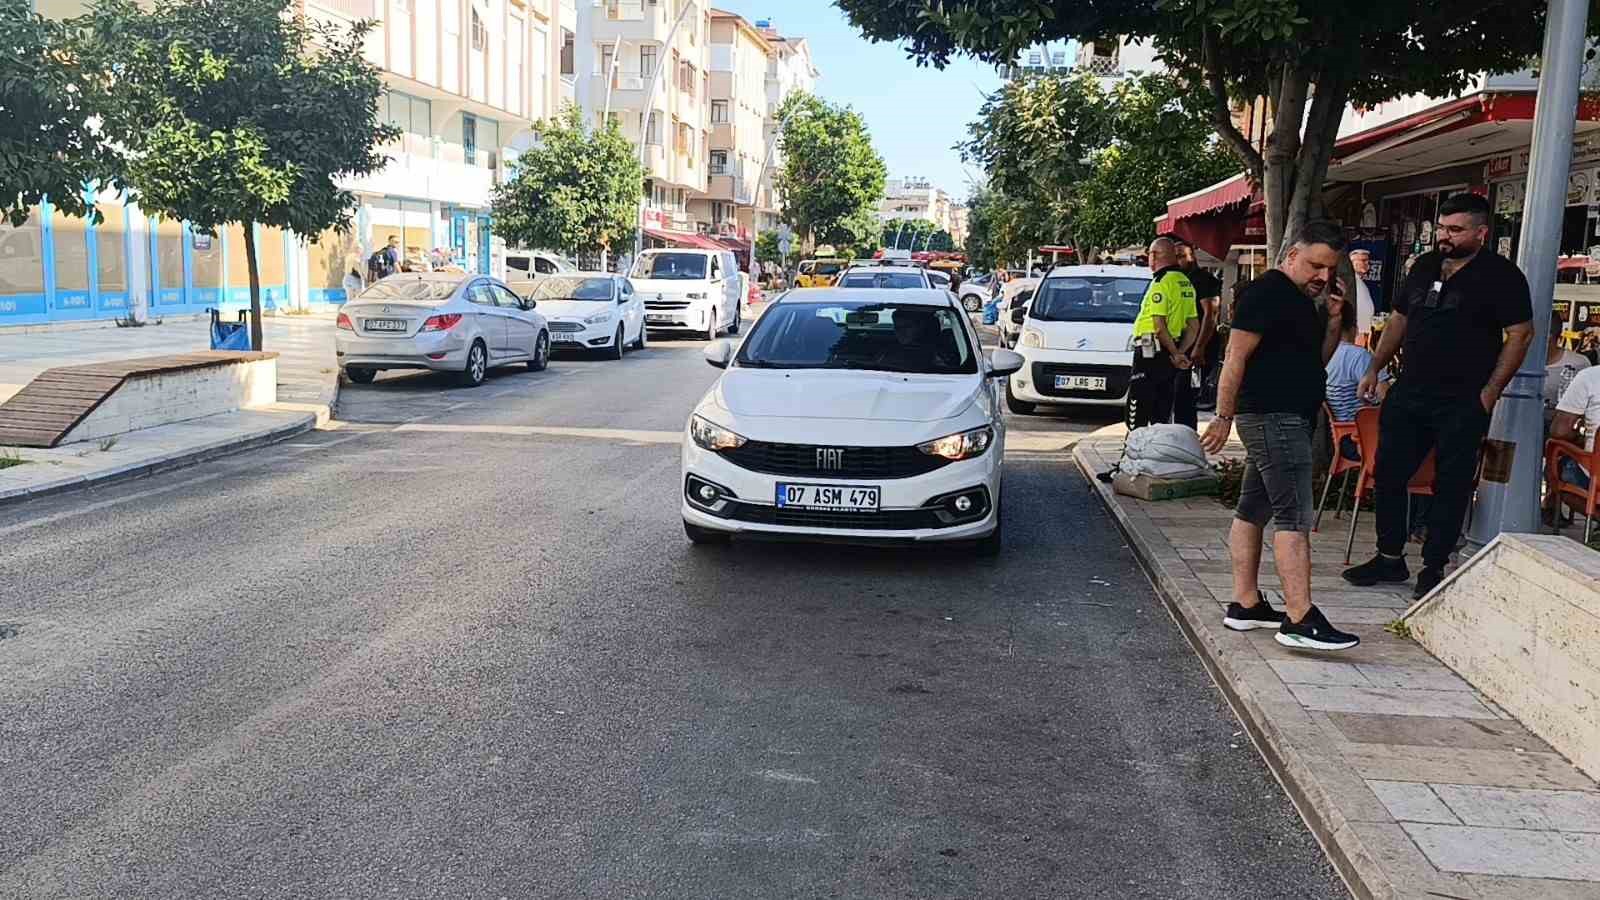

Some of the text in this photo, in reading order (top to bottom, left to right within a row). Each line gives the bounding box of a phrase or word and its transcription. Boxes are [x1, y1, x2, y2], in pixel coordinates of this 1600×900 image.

[816, 448, 845, 470] FIAT
[787, 487, 877, 507] 07 ASM 479
